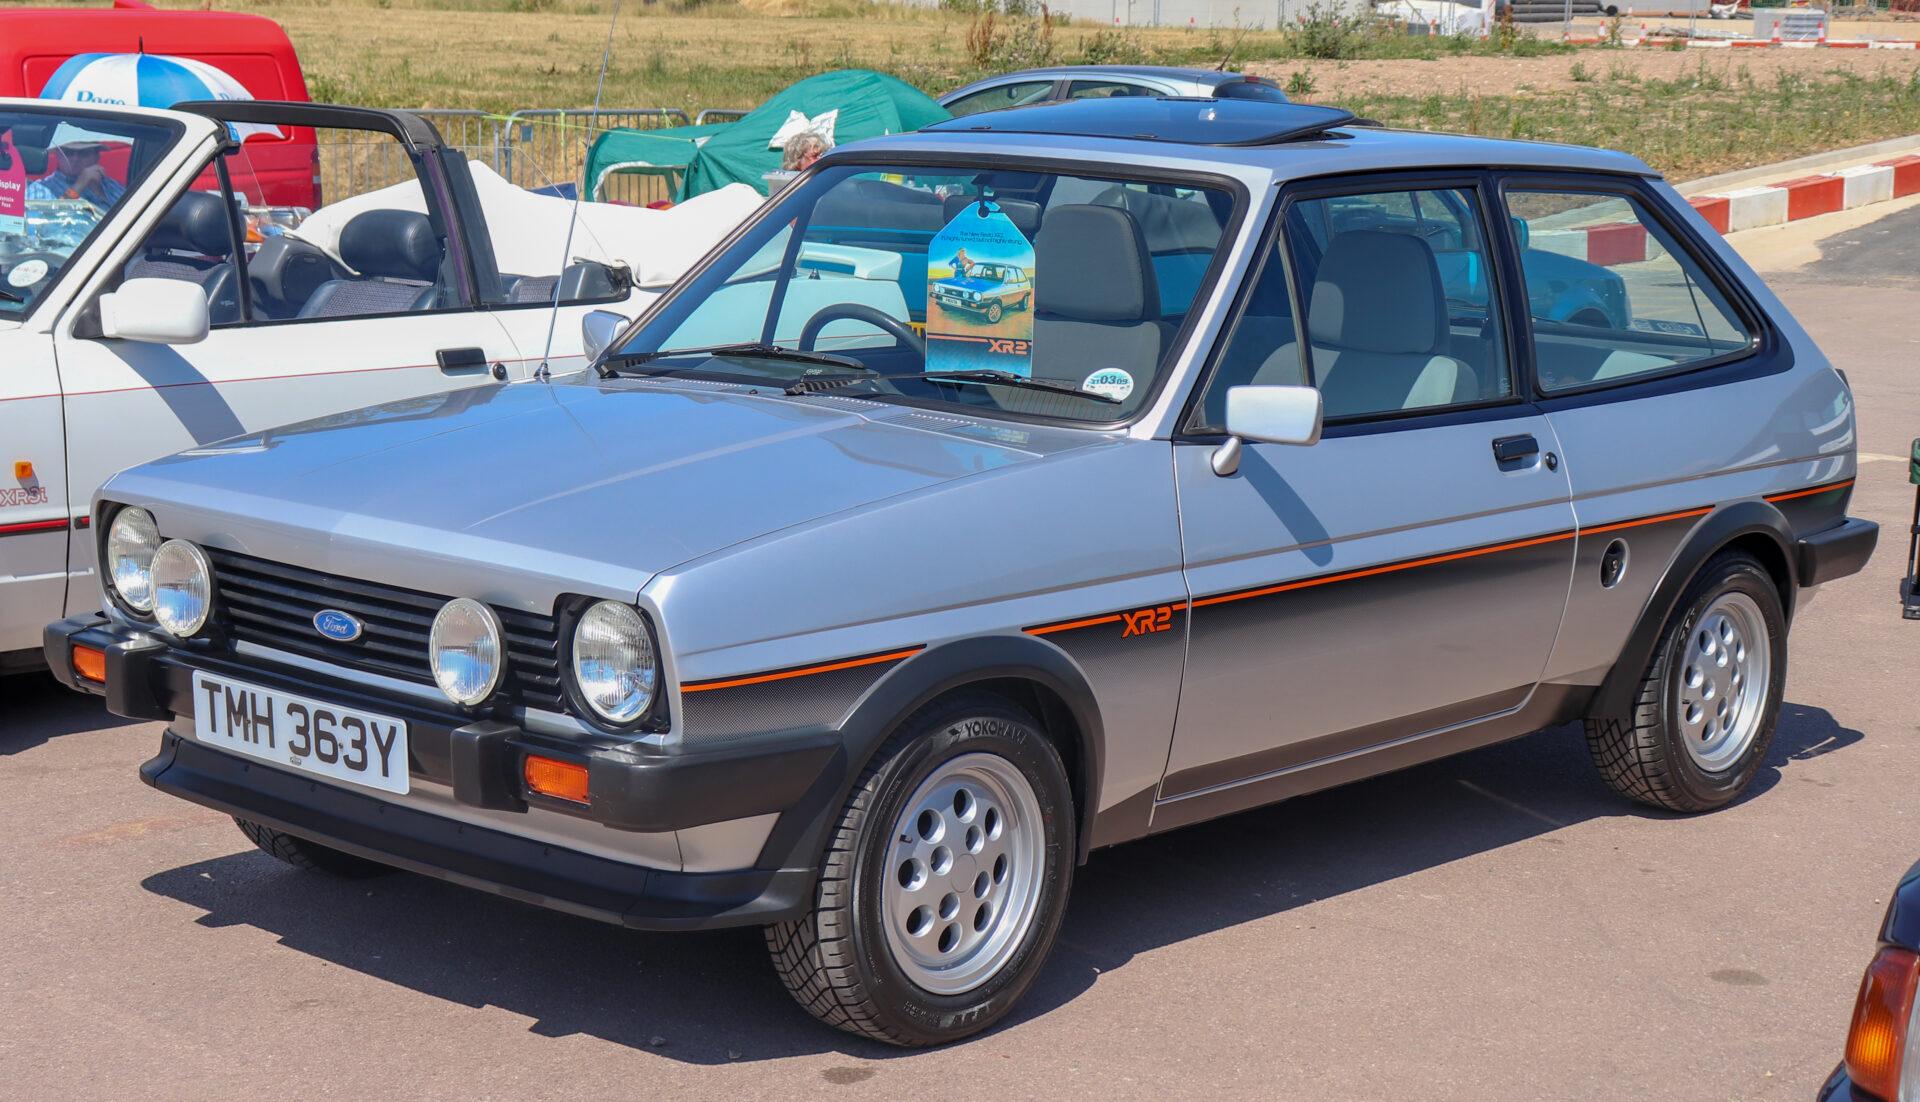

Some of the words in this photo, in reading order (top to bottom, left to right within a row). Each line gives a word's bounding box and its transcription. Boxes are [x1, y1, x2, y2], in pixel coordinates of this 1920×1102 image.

[988, 339, 1028, 355] XR2
[1100, 375, 1117, 385] 03
[0, 486, 48, 507] XR3i
[323, 615, 348, 634] Ford
[1121, 605, 1172, 639] XR2
[201, 679, 276, 749] TMH
[286, 702, 397, 778] 363Y
